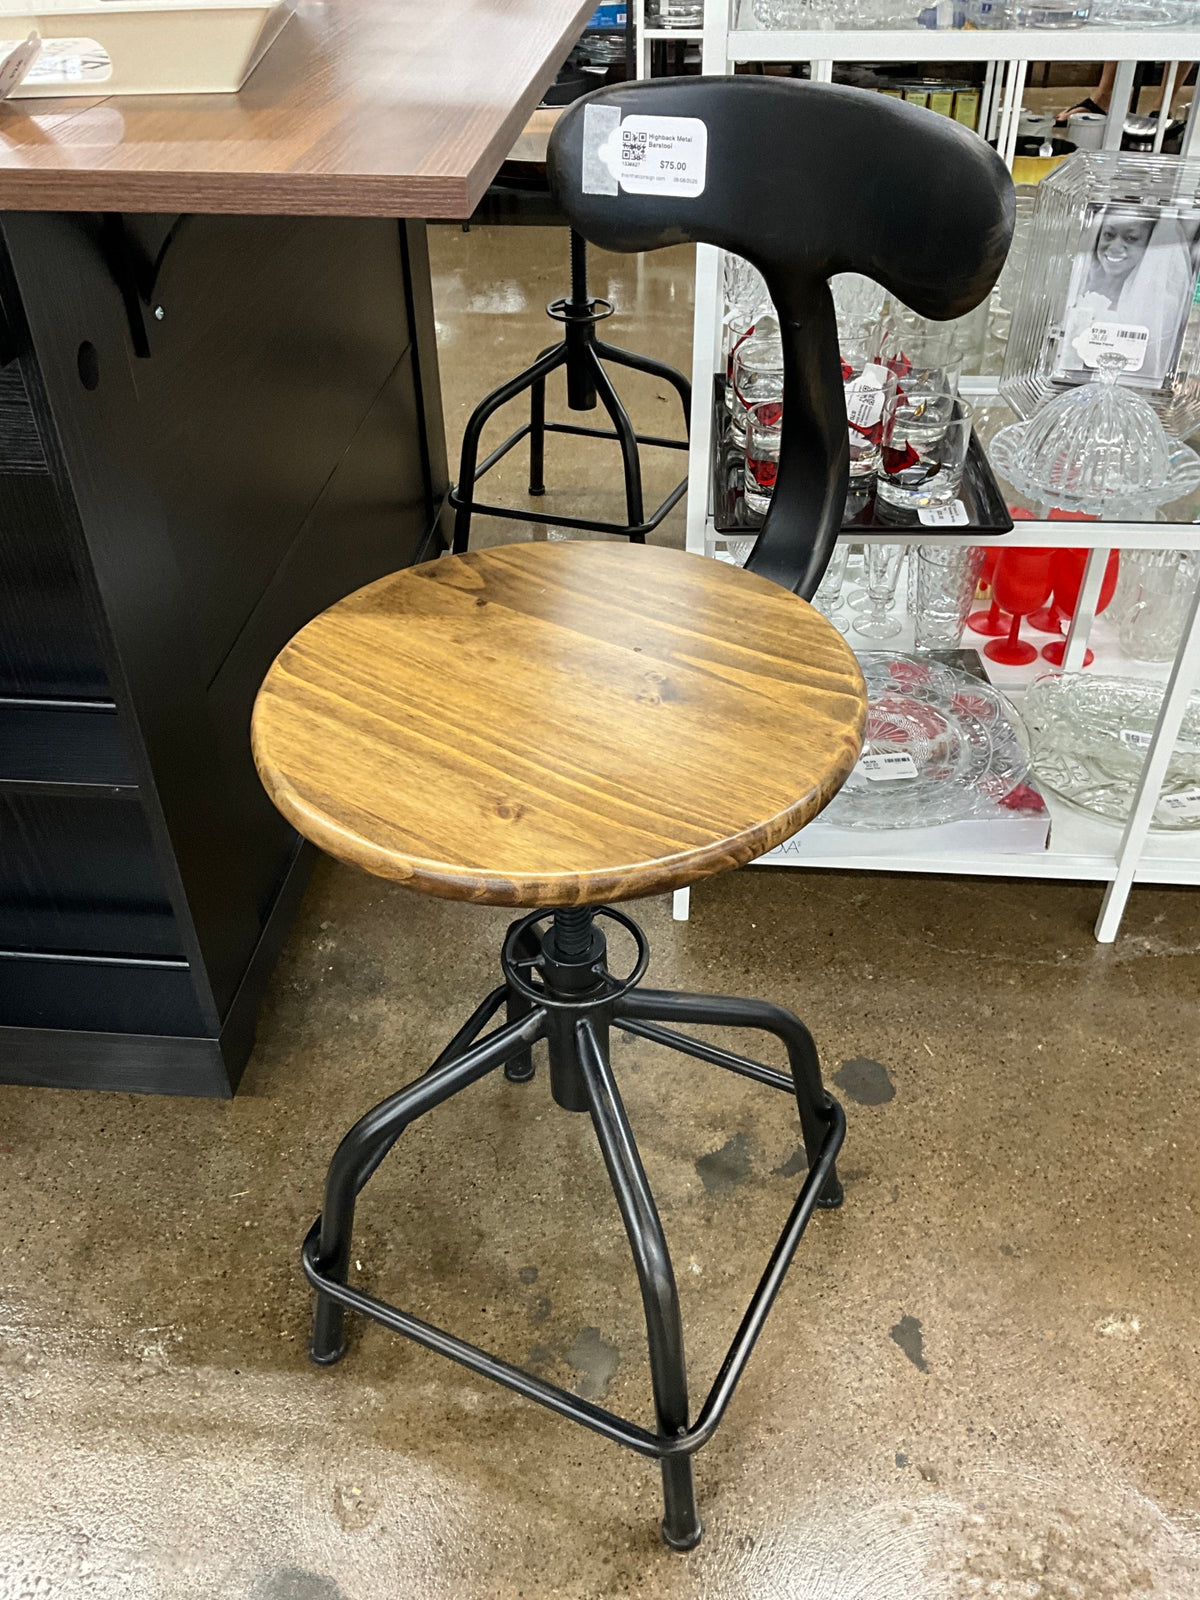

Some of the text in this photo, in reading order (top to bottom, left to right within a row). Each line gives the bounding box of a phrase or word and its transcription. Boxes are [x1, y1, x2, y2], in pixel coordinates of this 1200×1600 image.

[648, 133, 693, 143] Highback Metal
[648, 141, 673, 150] Barstool
[659, 160, 687, 171] $75.00
